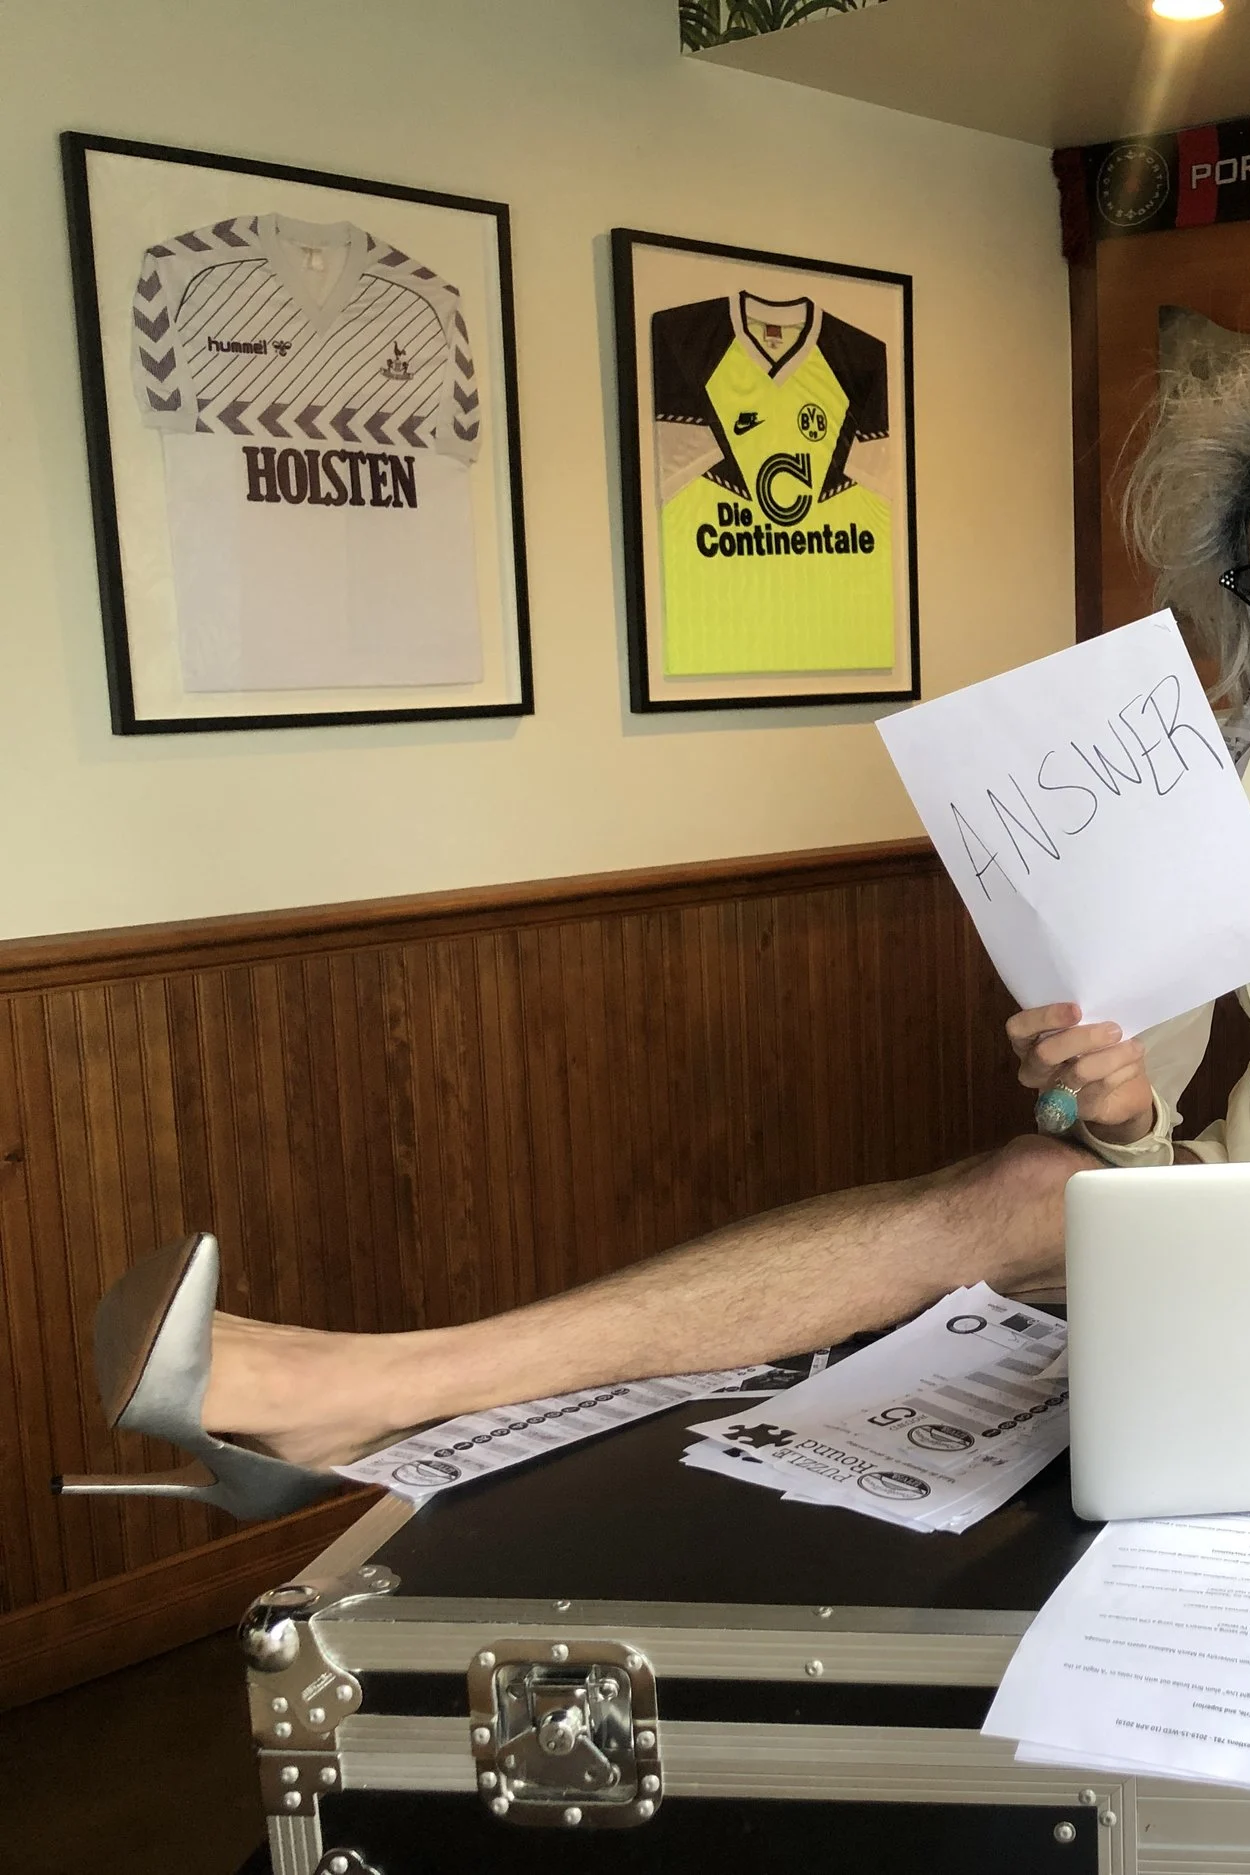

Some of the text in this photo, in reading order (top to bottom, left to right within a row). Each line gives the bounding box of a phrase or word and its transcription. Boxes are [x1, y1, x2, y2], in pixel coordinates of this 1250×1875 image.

[207, 336, 267, 355] hummel
[801, 407, 826, 432] BVB
[242, 446, 418, 508] HOLSTEN
[717, 502, 753, 527] Die
[696, 522, 876, 558] Continentale
[950, 674, 1224, 902] ANSWER
[867, 1406, 917, 1427] 5
[772, 1448, 852, 1483] PUZZLE
[795, 1439, 878, 1474] Round
[1192, 1700, 1222, 1713] Superior)
[1223, 1707, 1236, 1715] and
[1135, 1721, 1149, 1730] APR
[1213, 1735, 1225, 1744] 781
